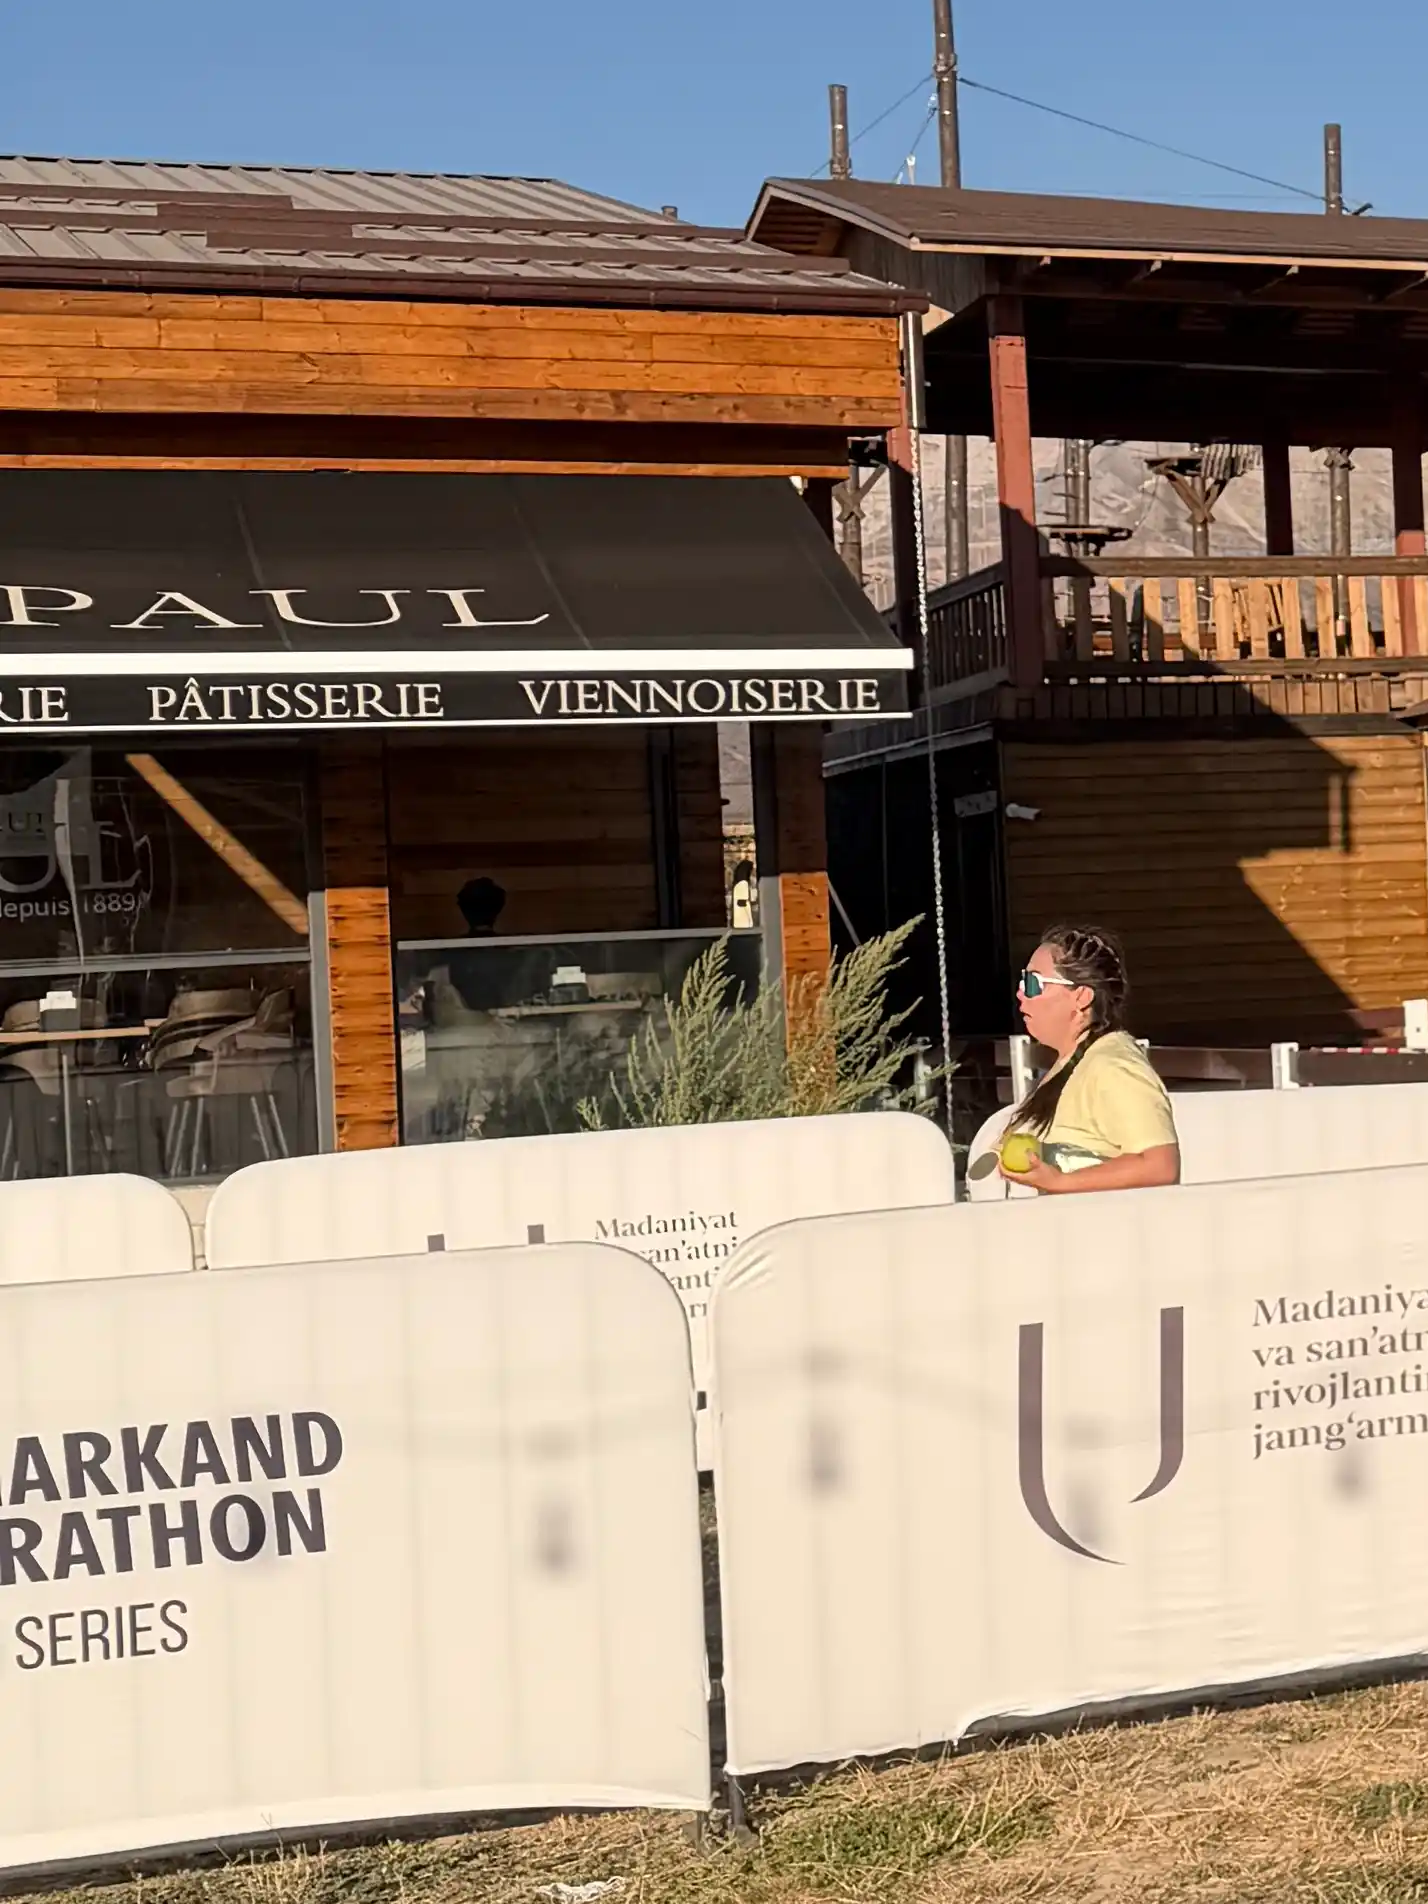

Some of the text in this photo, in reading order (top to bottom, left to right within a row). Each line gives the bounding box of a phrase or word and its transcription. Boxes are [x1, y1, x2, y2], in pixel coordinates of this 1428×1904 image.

[0, 584, 550, 629] PAUL
[147, 676, 444, 721] PÂTISSERIE
[519, 678, 881, 715] VIENNOISERIE
[0, 892, 137, 923] epuis 1889
[595, 1210, 738, 1240] Madaniyat
[1253, 1344, 1295, 1368] va
[0, 1411, 343, 1506] ARKAND
[0, 1487, 327, 1586] RATHON
[15, 1599, 188, 1670] SERIES
